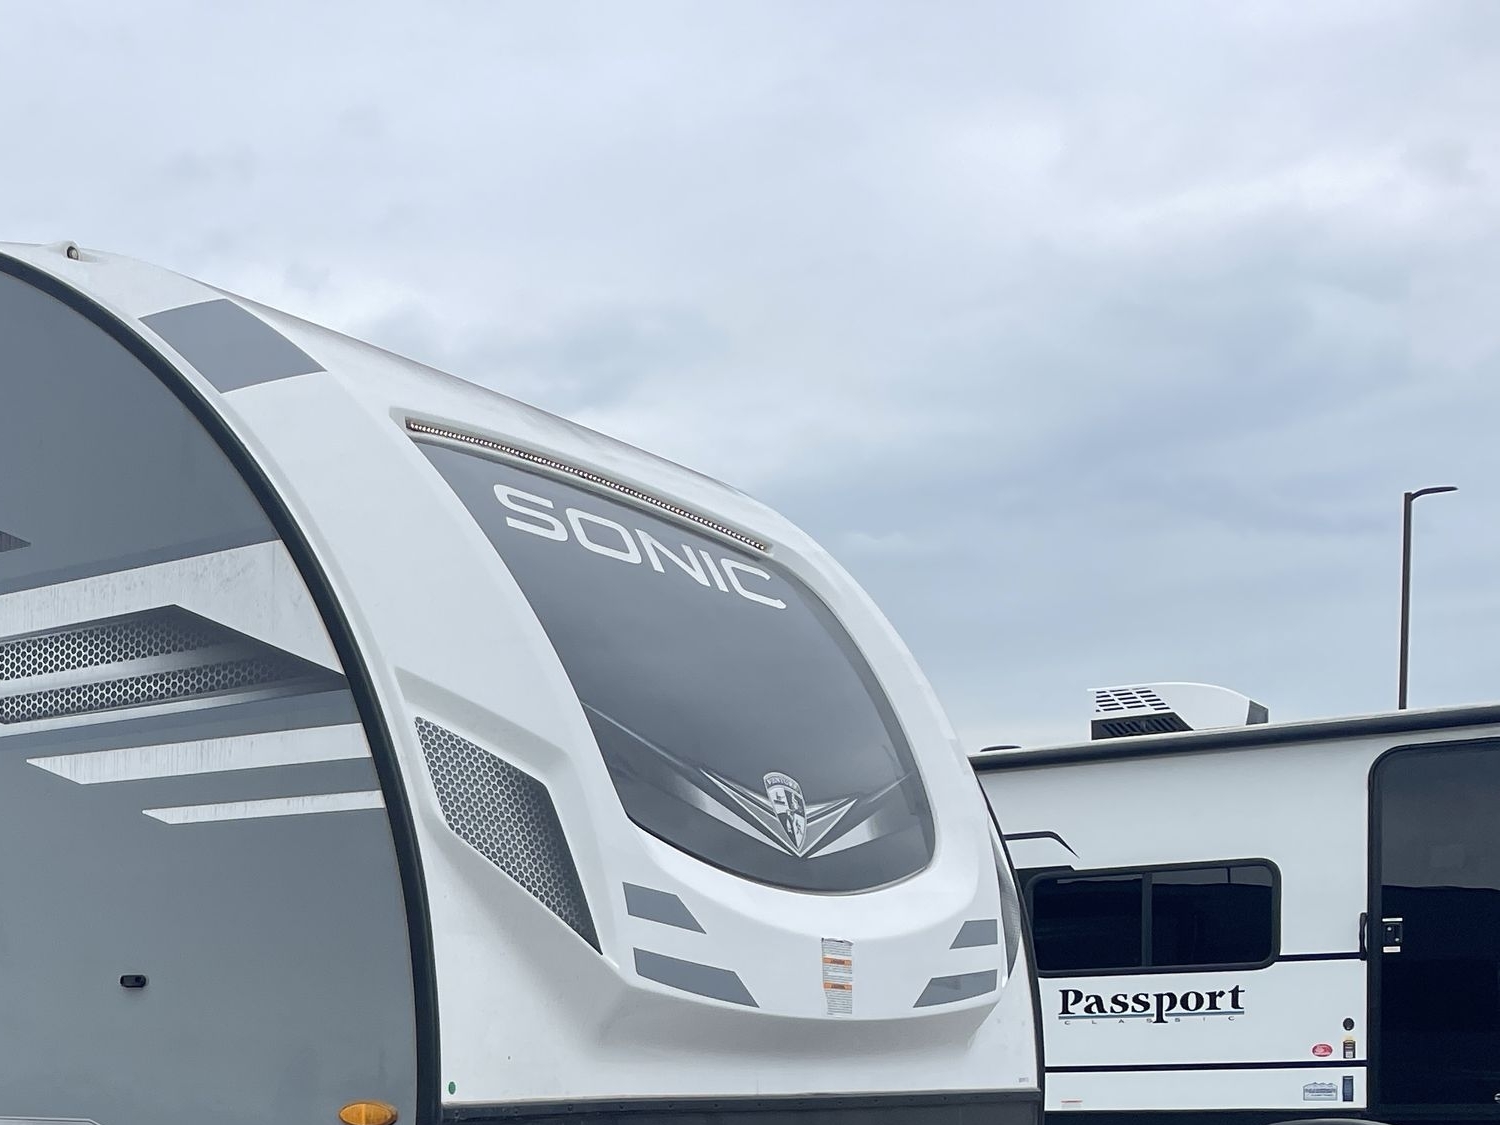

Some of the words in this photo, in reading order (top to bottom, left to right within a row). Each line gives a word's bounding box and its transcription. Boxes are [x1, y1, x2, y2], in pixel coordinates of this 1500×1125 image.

[493, 484, 787, 609] SONIC
[1059, 985, 1246, 1024] Passport
[1064, 1015, 1235, 1026] CLASSIC
